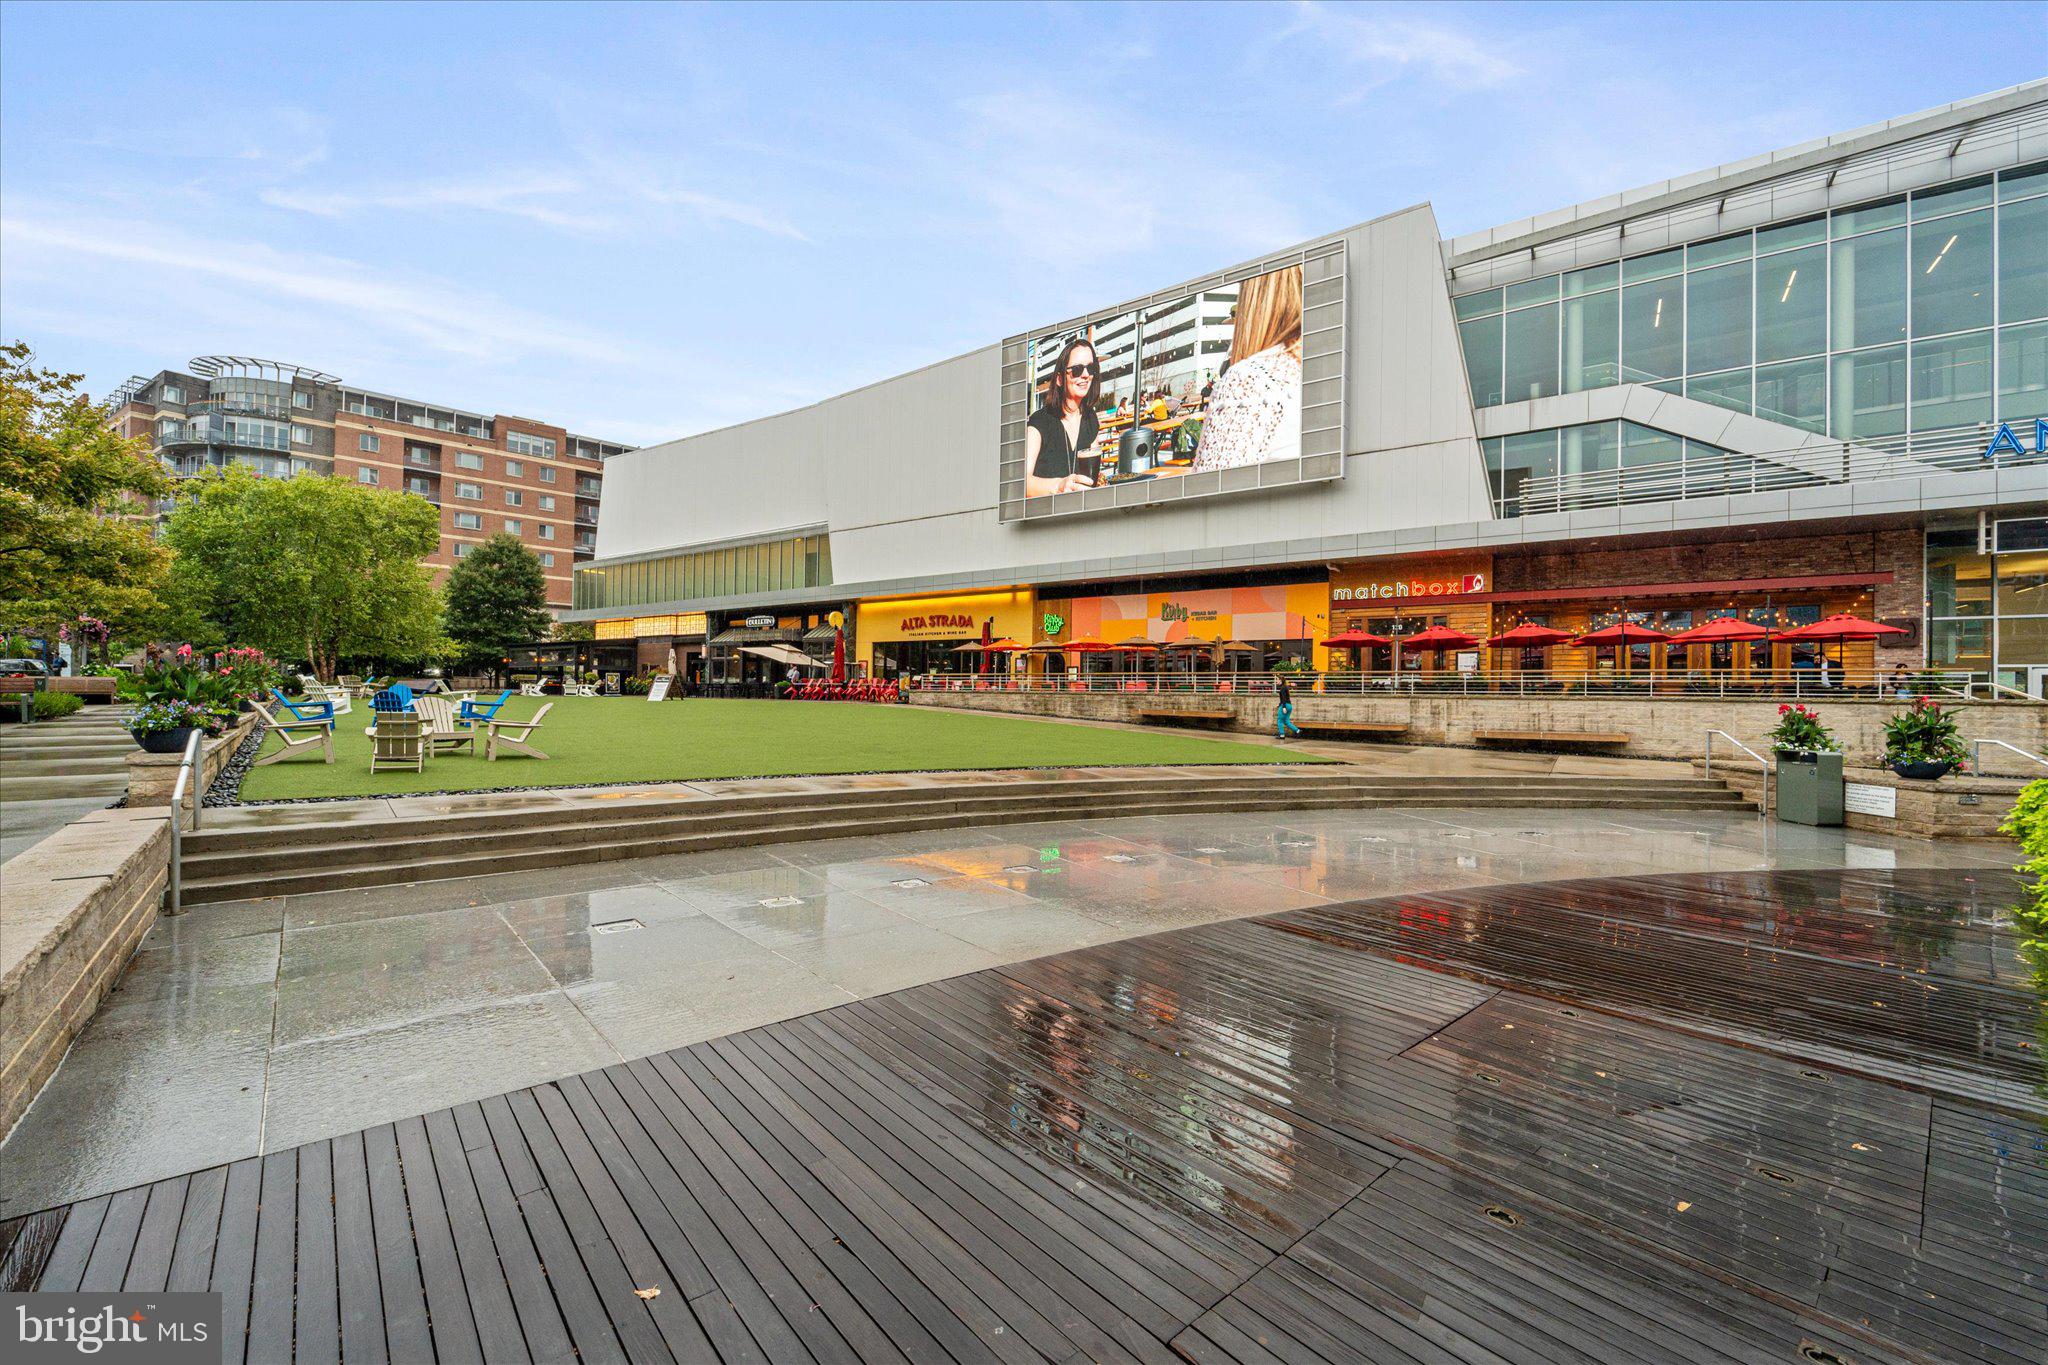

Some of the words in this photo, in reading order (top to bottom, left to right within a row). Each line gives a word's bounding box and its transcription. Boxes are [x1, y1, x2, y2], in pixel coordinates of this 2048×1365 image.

[1333, 581, 1459, 600] matchbox
[901, 616, 928, 632] ALTA
[928, 614, 974, 629] STRADA
